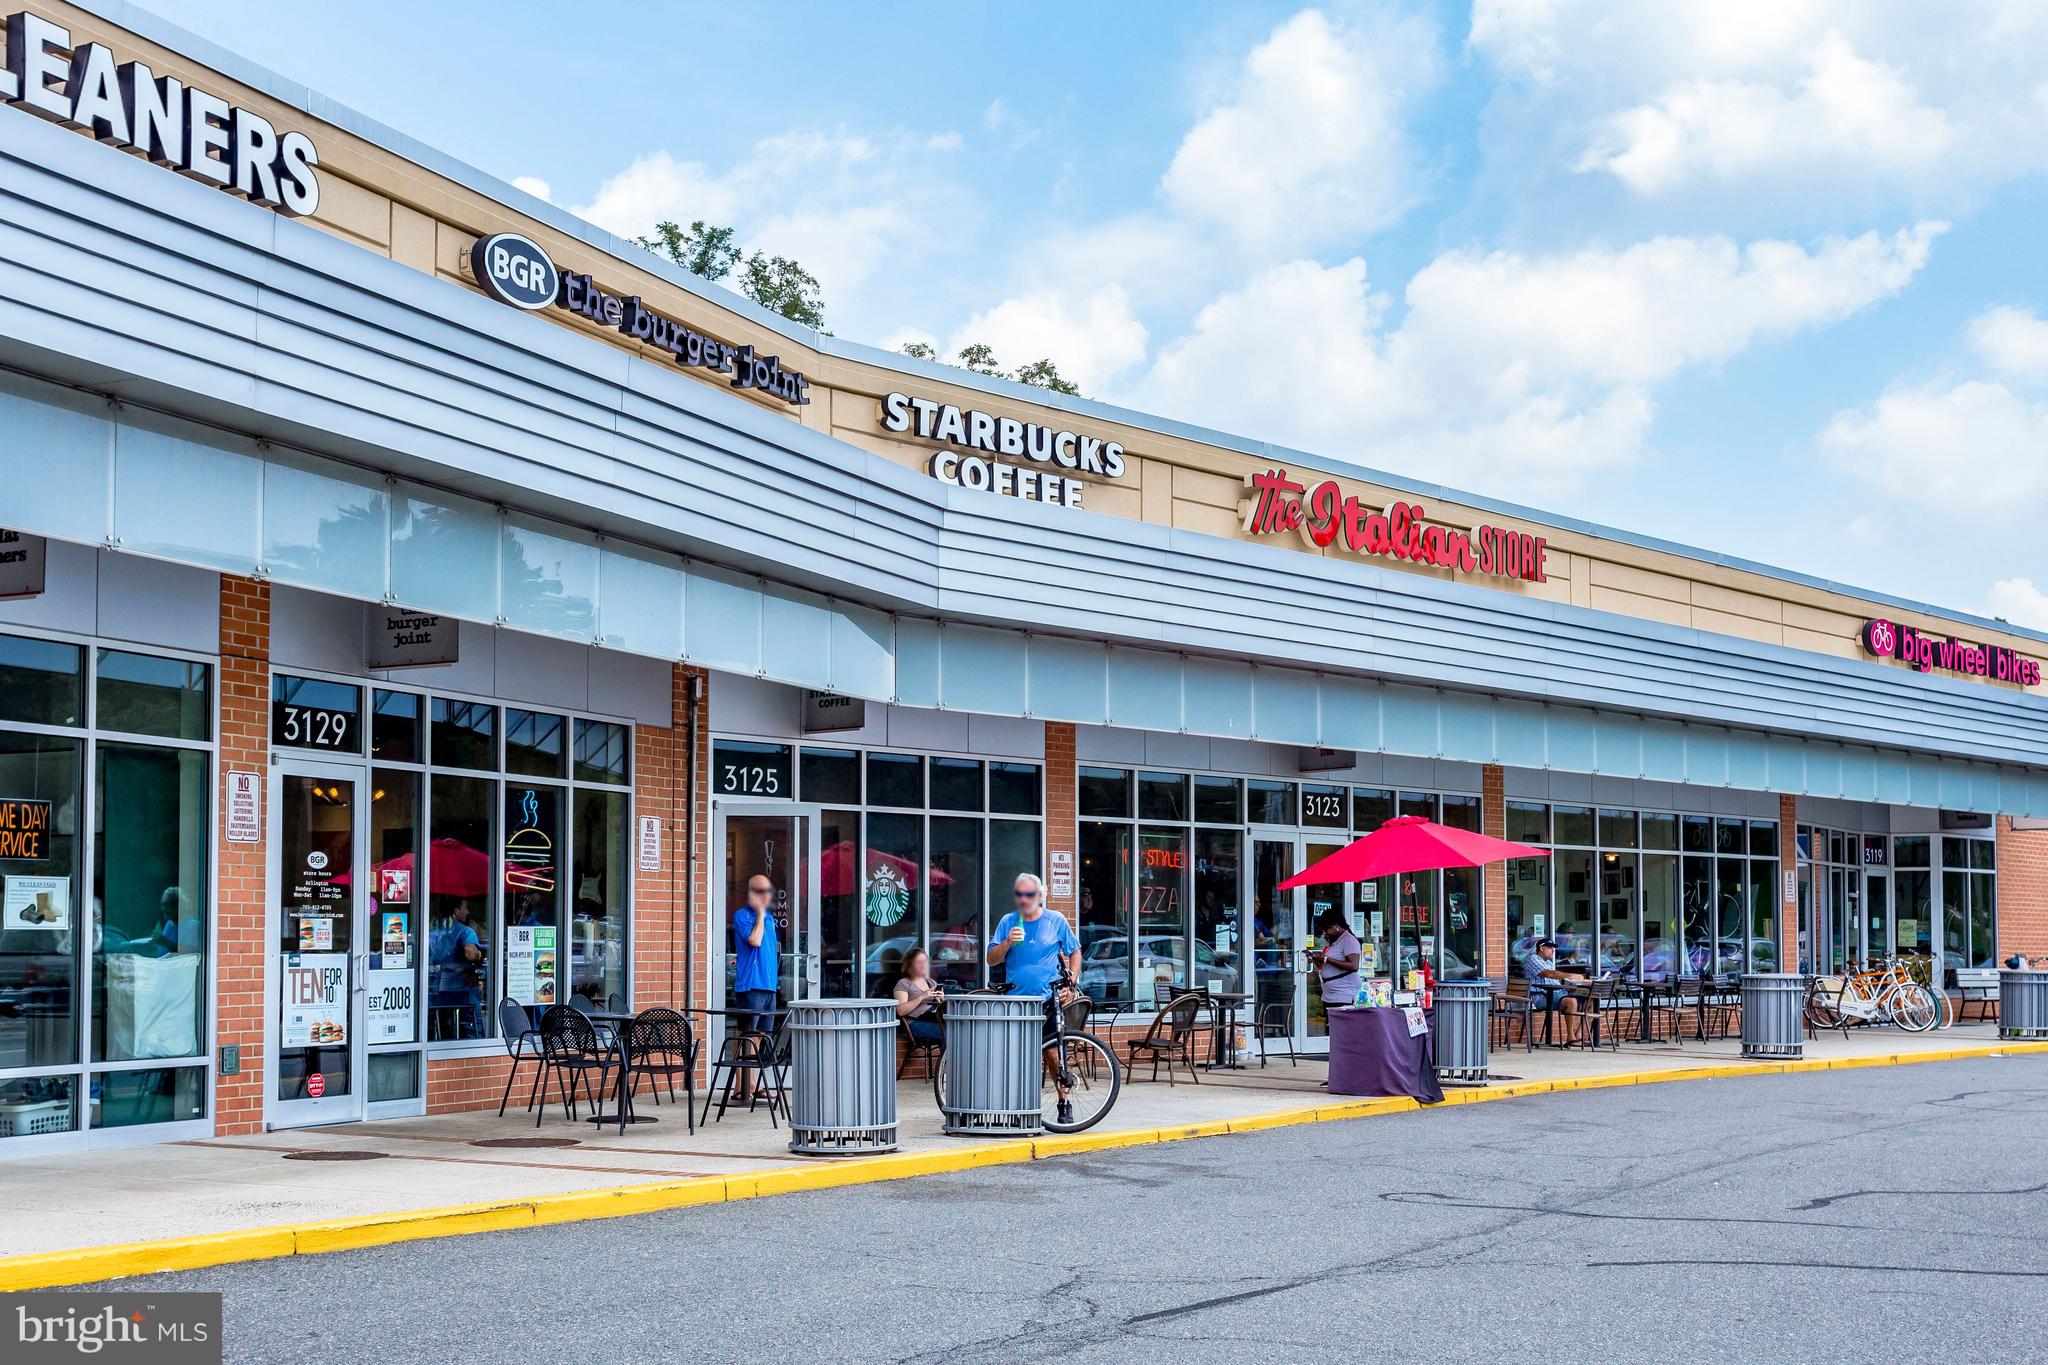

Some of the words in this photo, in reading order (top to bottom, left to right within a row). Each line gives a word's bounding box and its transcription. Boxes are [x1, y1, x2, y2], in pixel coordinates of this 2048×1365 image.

[493, 246, 548, 296] BGR
[561, 271, 622, 326] the
[625, 296, 736, 373] burger
[736, 345, 810, 405] joint
[882, 392, 1126, 478] STARBUCKS
[931, 450, 1085, 510] COFFEE
[1252, 469, 1304, 536] The
[1305, 480, 1478, 574] Italian
[1478, 524, 1547, 583] STORE
[387, 616, 438, 630] burger
[394, 632, 432, 648] joint
[1902, 624, 1933, 673] big
[1938, 637, 1991, 678] wheel
[1997, 645, 2041, 686] bikes
[819, 697, 850, 708] COFFEE
[284, 707, 346, 745] 3129
[238, 776, 249, 790] NO
[724, 765, 778, 794] 3125
[21, 803, 49, 830] DAY
[1306, 795, 1340, 817] 3123
[0, 831, 39, 857] RVICE
[1865, 848, 1882, 863] 3119
[310, 855, 325, 864] BGR
[1053, 862, 1070, 870] PARKING
[1146, 848, 1183, 869] STYLE
[1388, 905, 1428, 923] EESE
[519, 930, 530, 942] BGR
[288, 968, 323, 1004] TEN
[324, 968, 342, 985] FOR
[324, 986, 334, 1003] 10
[369, 996, 382, 1008] EST
[383, 986, 411, 1011] 2008
